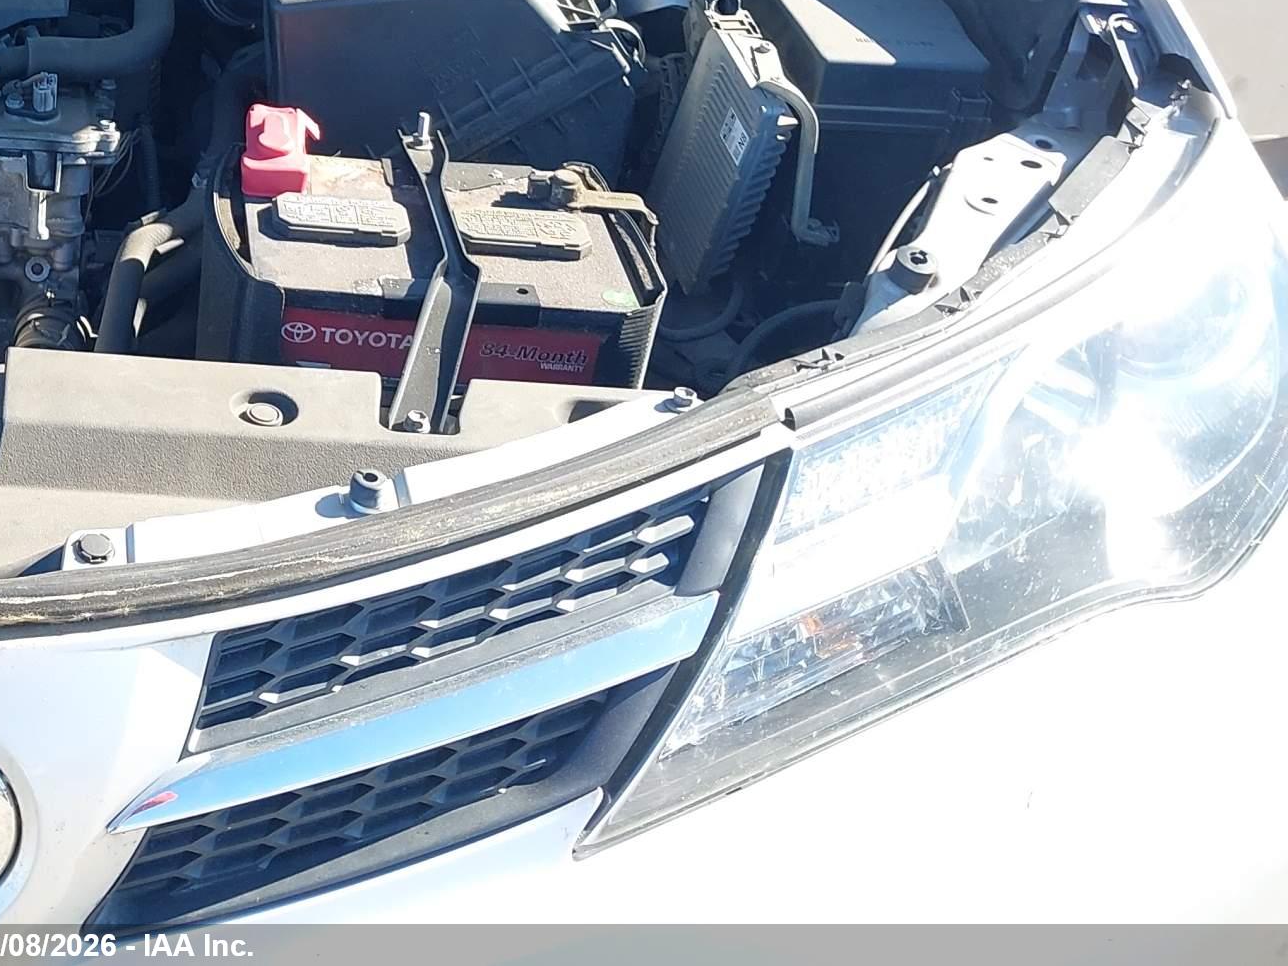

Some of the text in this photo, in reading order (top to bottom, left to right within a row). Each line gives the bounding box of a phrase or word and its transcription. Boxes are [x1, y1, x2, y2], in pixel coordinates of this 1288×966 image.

[321, 326, 413, 350] TOYOTA
[480, 342, 588, 365] 84-Month
[540, 361, 585, 373] WARRANTY
